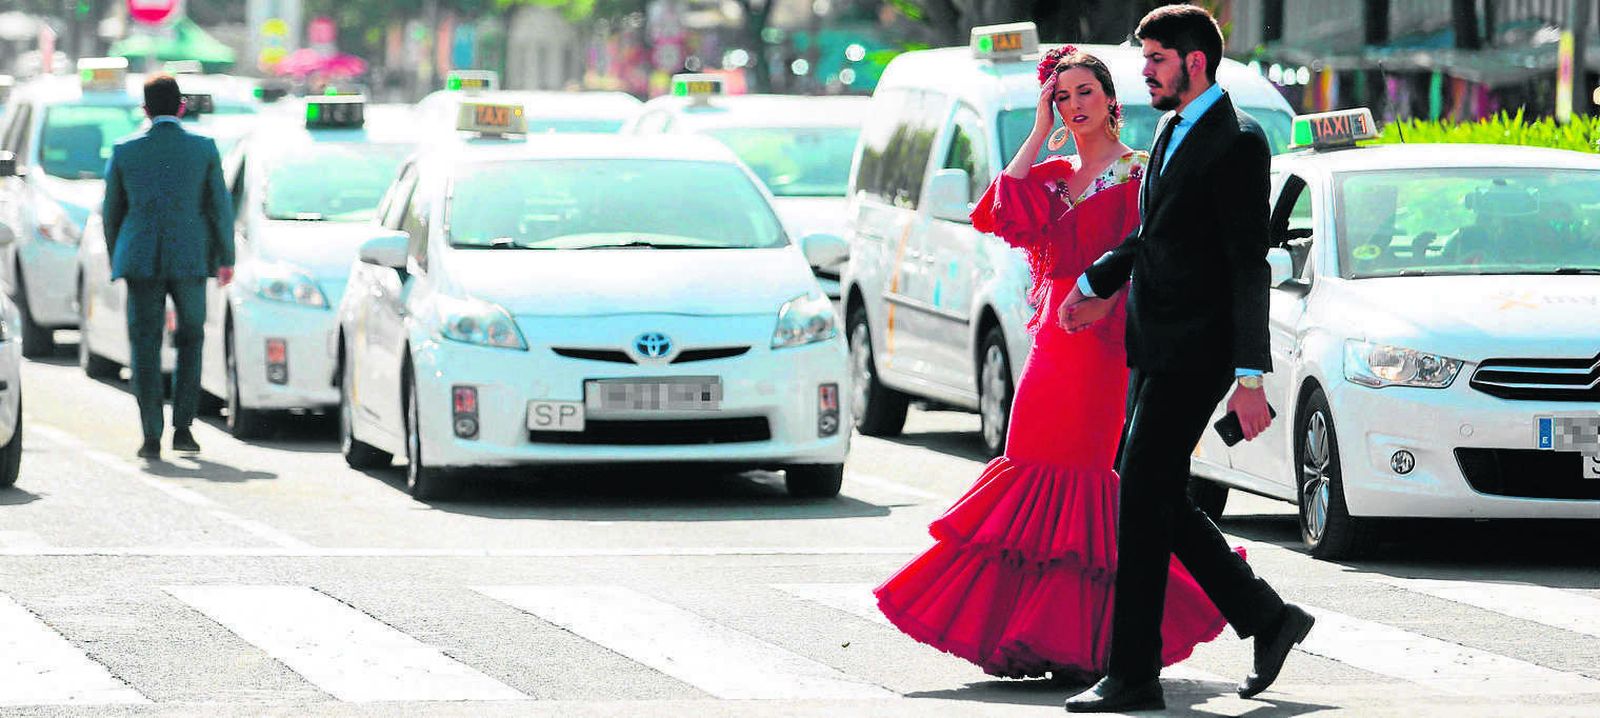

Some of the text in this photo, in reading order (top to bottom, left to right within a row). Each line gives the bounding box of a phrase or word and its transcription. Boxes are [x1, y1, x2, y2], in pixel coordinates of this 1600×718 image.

[992, 33, 1023, 51] TAXI
[476, 104, 510, 127] TAXI
[1312, 113, 1368, 139] TAXI 1
[535, 403, 576, 427] SP
[1542, 436, 1549, 445] E
